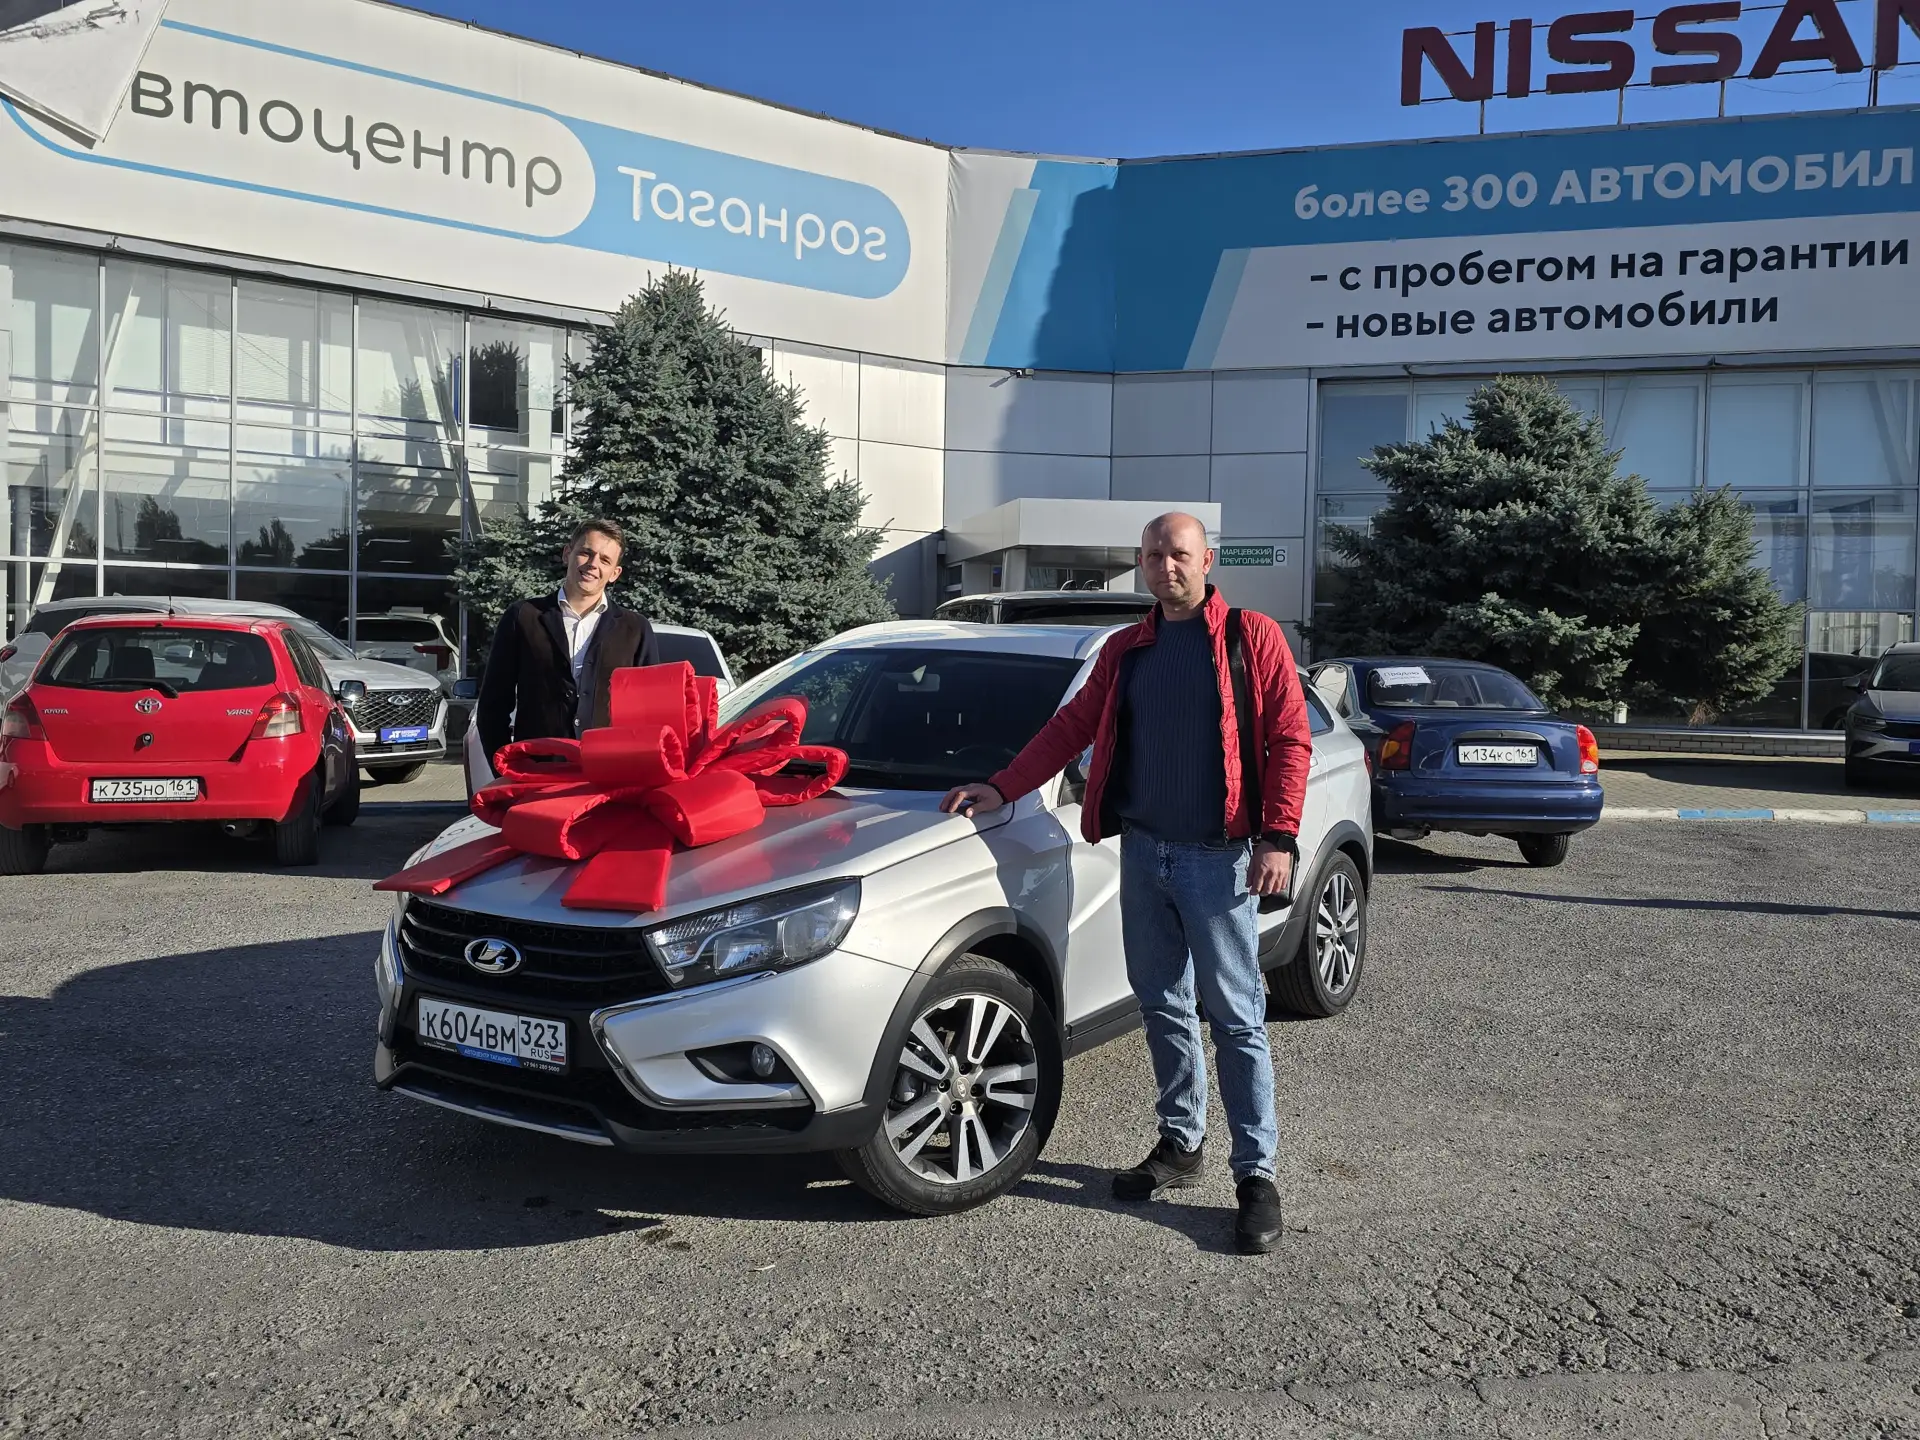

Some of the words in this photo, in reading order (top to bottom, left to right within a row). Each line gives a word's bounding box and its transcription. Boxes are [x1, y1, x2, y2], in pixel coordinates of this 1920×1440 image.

[131, 71, 562, 208] втоцентр
[617, 165, 887, 261] Таганрог
[1294, 184, 1430, 219] более
[1441, 171, 1538, 211] 300
[1339, 266, 1361, 290] с
[1374, 249, 1595, 297] пробегом
[1610, 251, 1663, 279] на
[1679, 239, 1908, 283] гарантии
[1336, 307, 1475, 338] новые
[1487, 290, 1778, 333] автомобили
[1221, 547, 1272, 556] МАРЦЕВСКИЙ
[1275, 549, 1286, 562] 6
[1221, 557, 1272, 565] ТРЕУГОЛЬНИК
[226, 708, 253, 716] YARIS
[1516, 748, 1534, 758] 161
[99, 781, 164, 796] К735НО
[168, 780, 193, 791] 161
[426, 1008, 516, 1053] К604ВМ
[521, 1020, 559, 1050] 323
[531, 1049, 550, 1060] RUS
